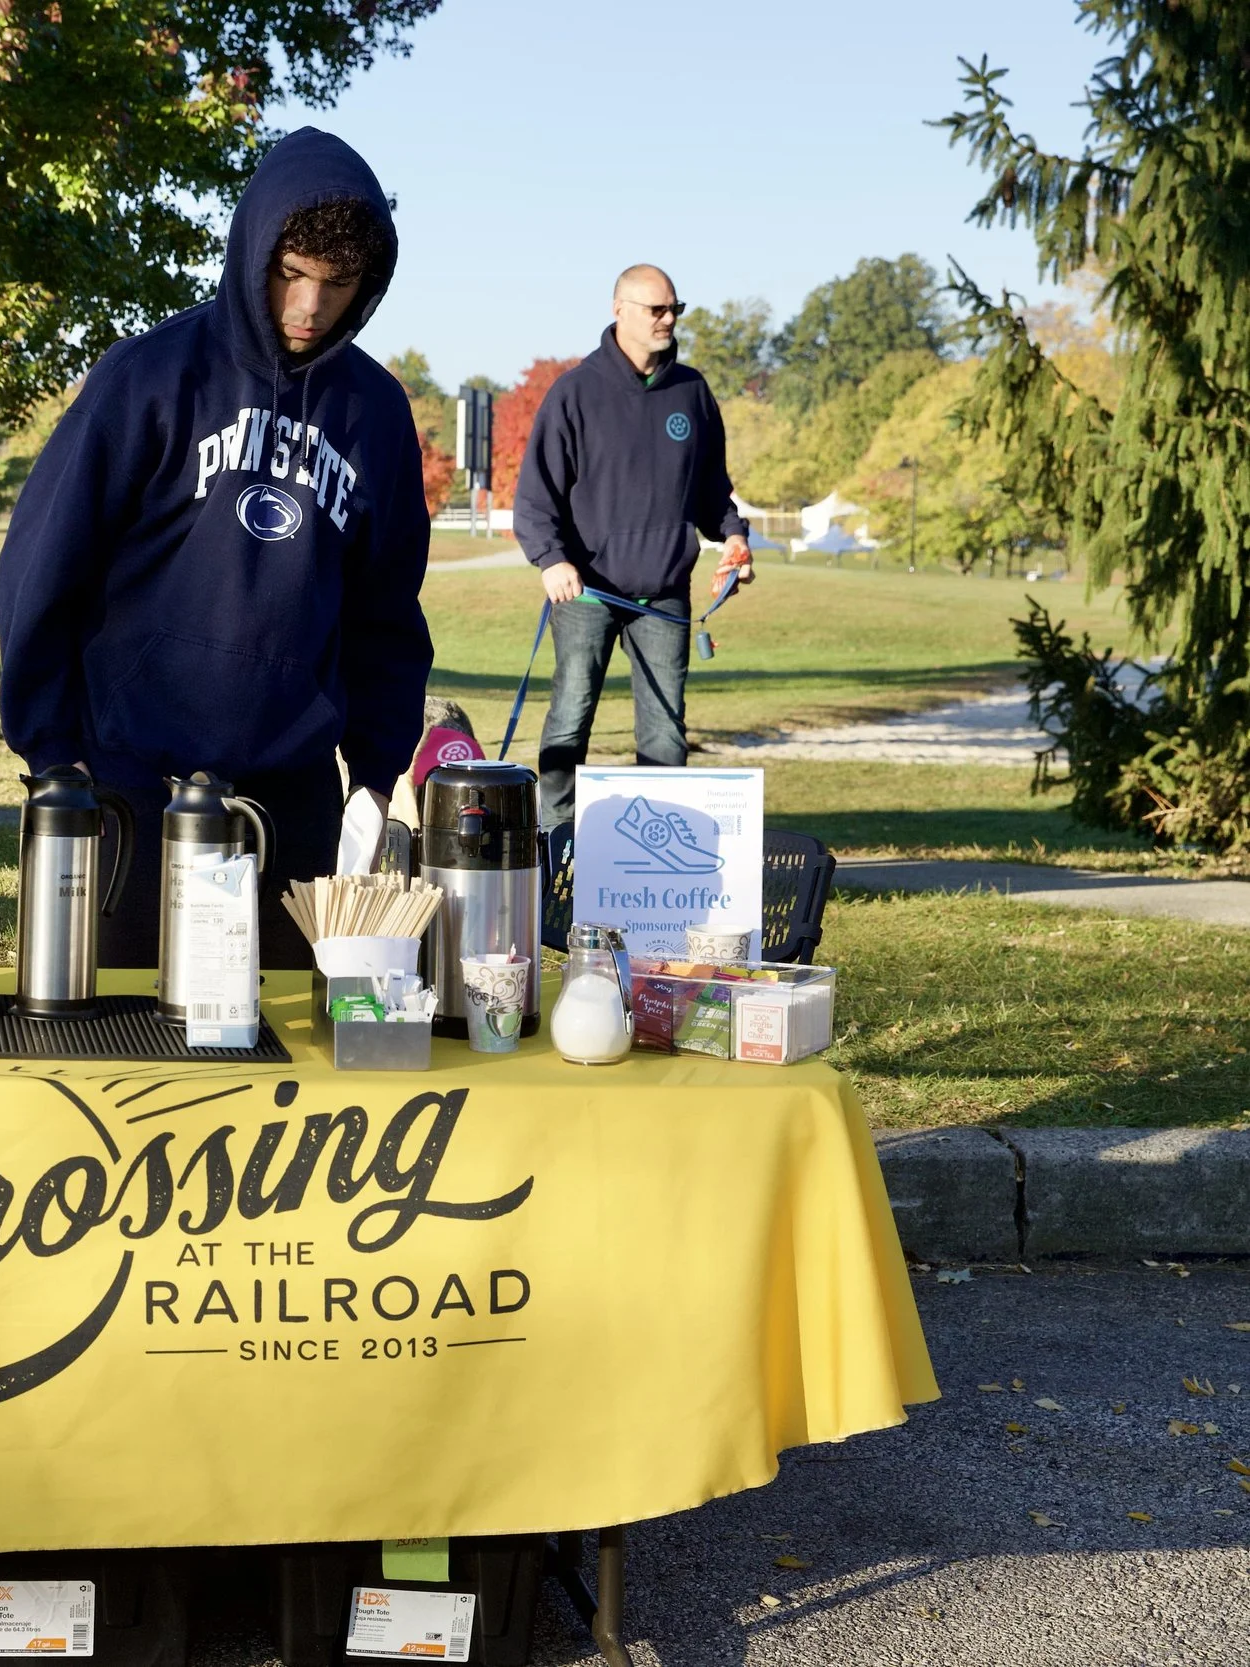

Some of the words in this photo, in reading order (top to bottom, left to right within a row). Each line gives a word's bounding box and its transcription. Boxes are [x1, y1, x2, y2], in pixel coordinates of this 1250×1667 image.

[271, 415, 357, 531] STTE
[59, 887, 86, 897] Milk
[598, 887, 656, 909] Fresh
[662, 887, 731, 909] Coffee
[625, 919, 687, 933] Sponsored
[654, 983, 672, 993] yog
[691, 1021, 716, 1029] GREEN
[176, 1242, 222, 1267] AT
[244, 1241, 314, 1266] THE
[145, 1269, 531, 1325] RAILROAD
[239, 1339, 340, 1361] SINCE
[361, 1336, 439, 1360] 2013
[356, 1591, 391, 1606] HDX
[355, 1607, 375, 1615] Tough
[33, 1640, 42, 1648] 17
[407, 1644, 416, 1652] 12
